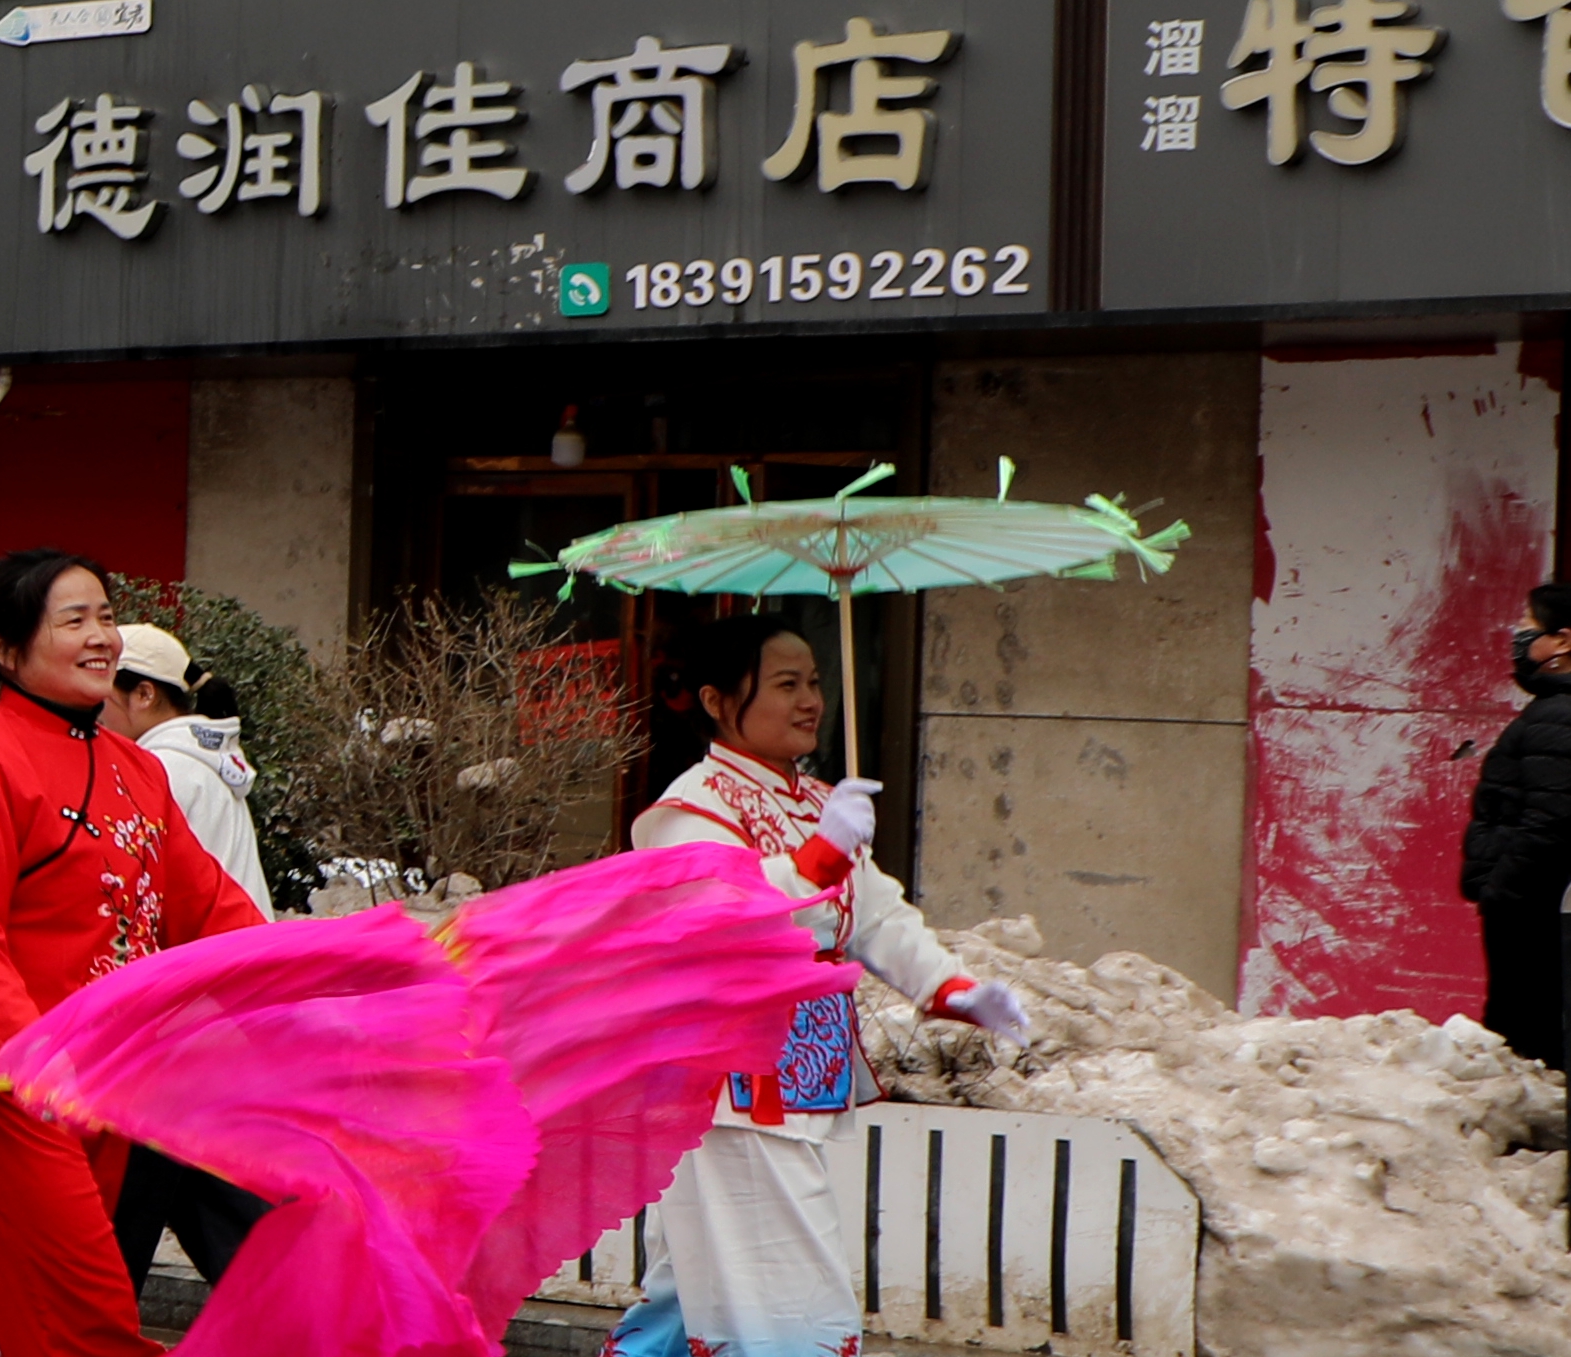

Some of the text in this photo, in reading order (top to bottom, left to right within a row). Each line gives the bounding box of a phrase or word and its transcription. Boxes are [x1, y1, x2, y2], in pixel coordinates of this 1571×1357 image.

[23, 16, 966, 241] 德润佳商店
[1141, 19, 1205, 152] 溜溜
[624, 244, 1031, 310] 18391592262
